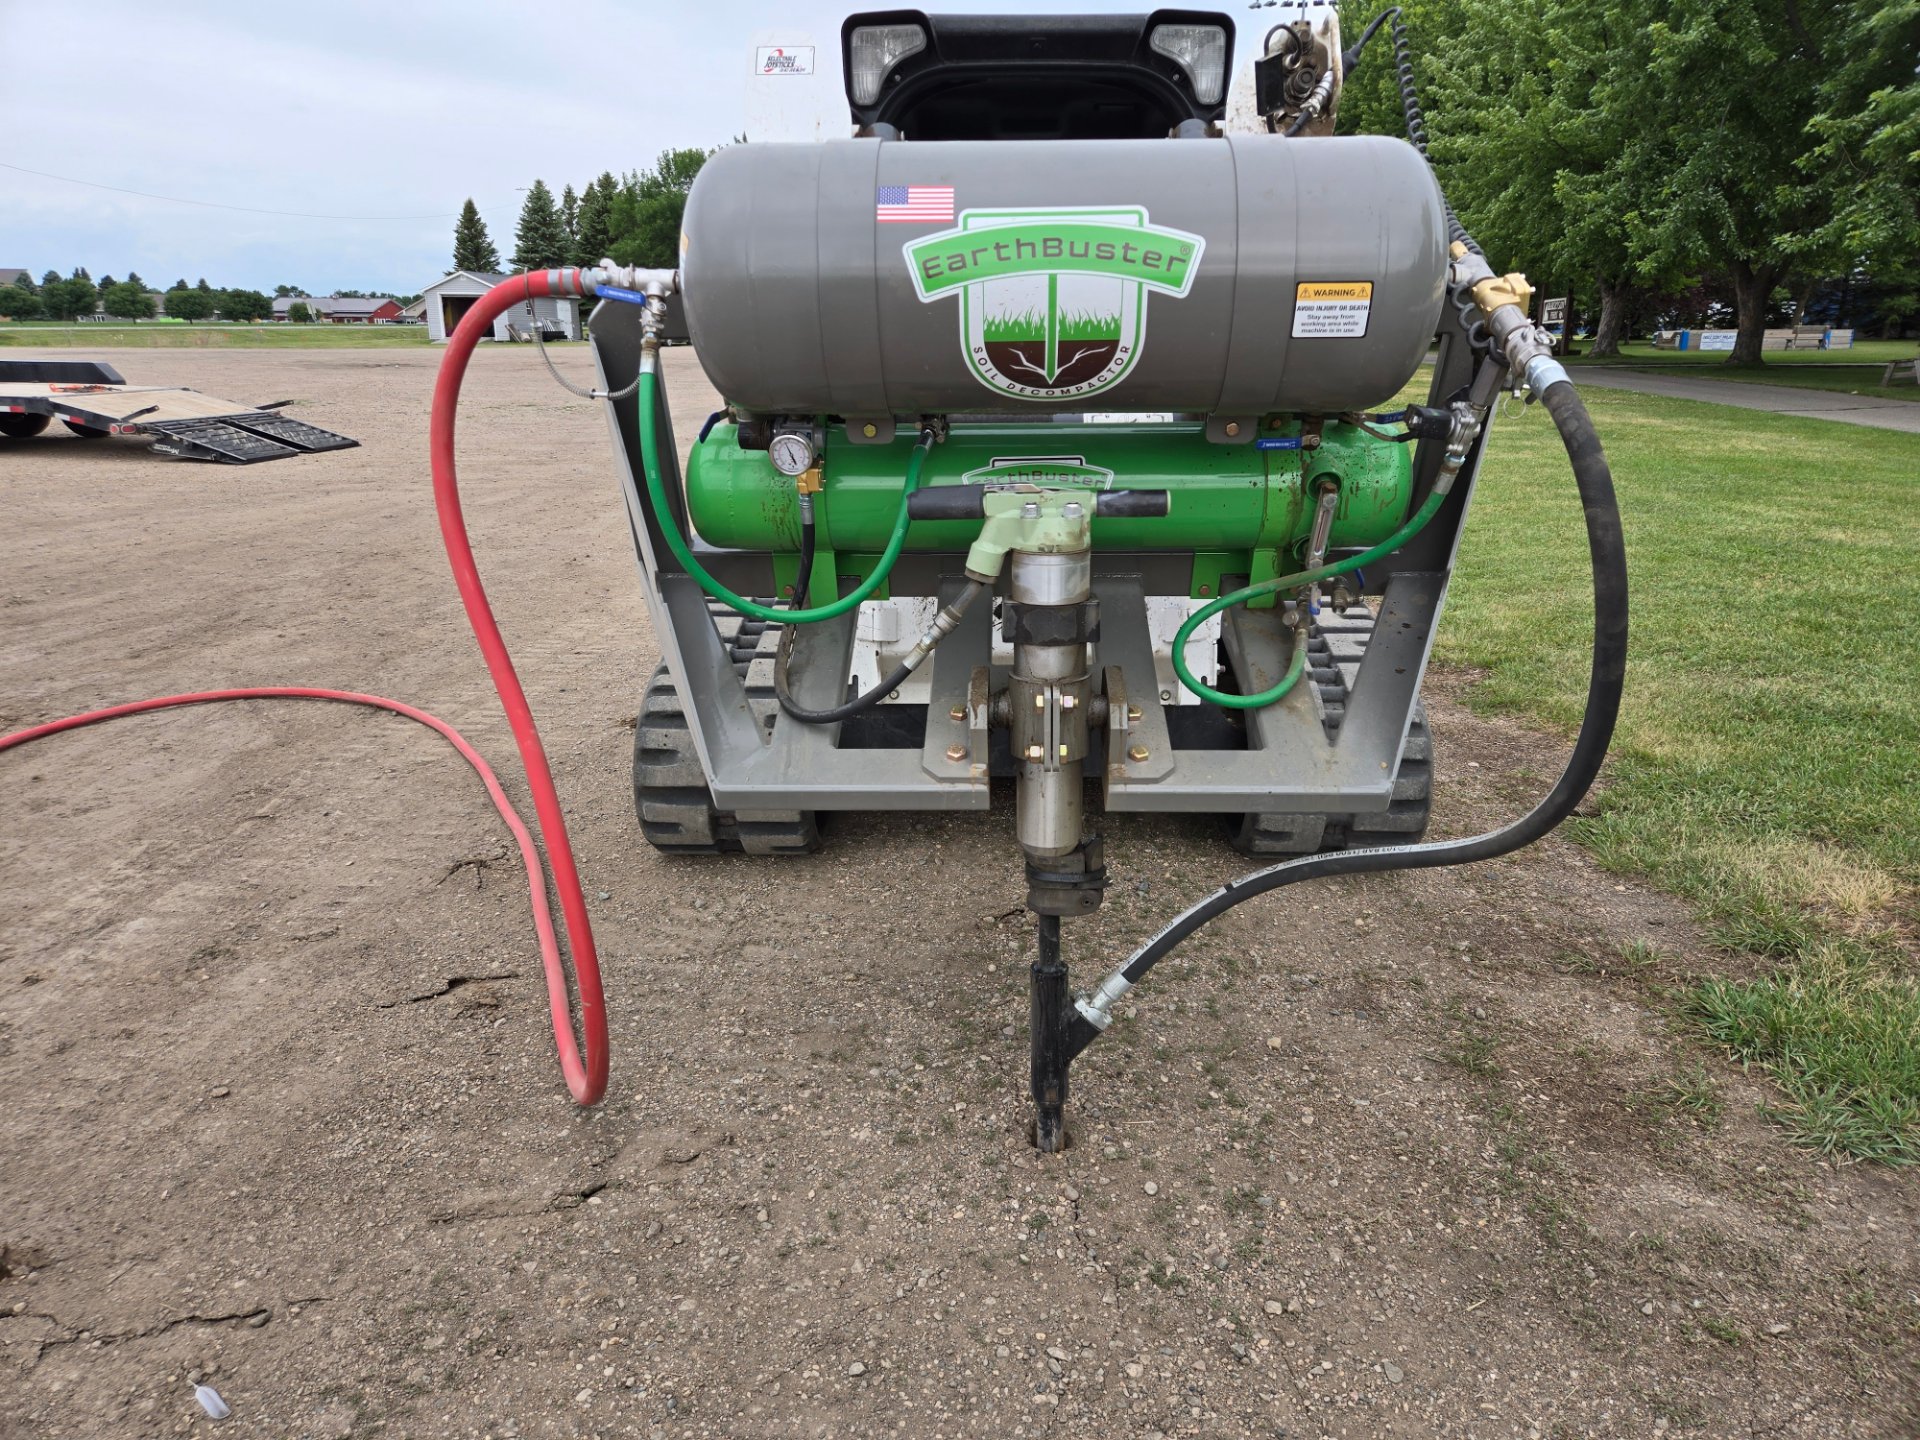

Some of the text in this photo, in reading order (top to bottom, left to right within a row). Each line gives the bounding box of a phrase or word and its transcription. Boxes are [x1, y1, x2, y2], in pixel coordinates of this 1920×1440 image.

[1313, 289, 1356, 297] WARNING
[972, 346, 997, 381] SOIL
[1006, 345, 1131, 396] DECOMPACTOR
